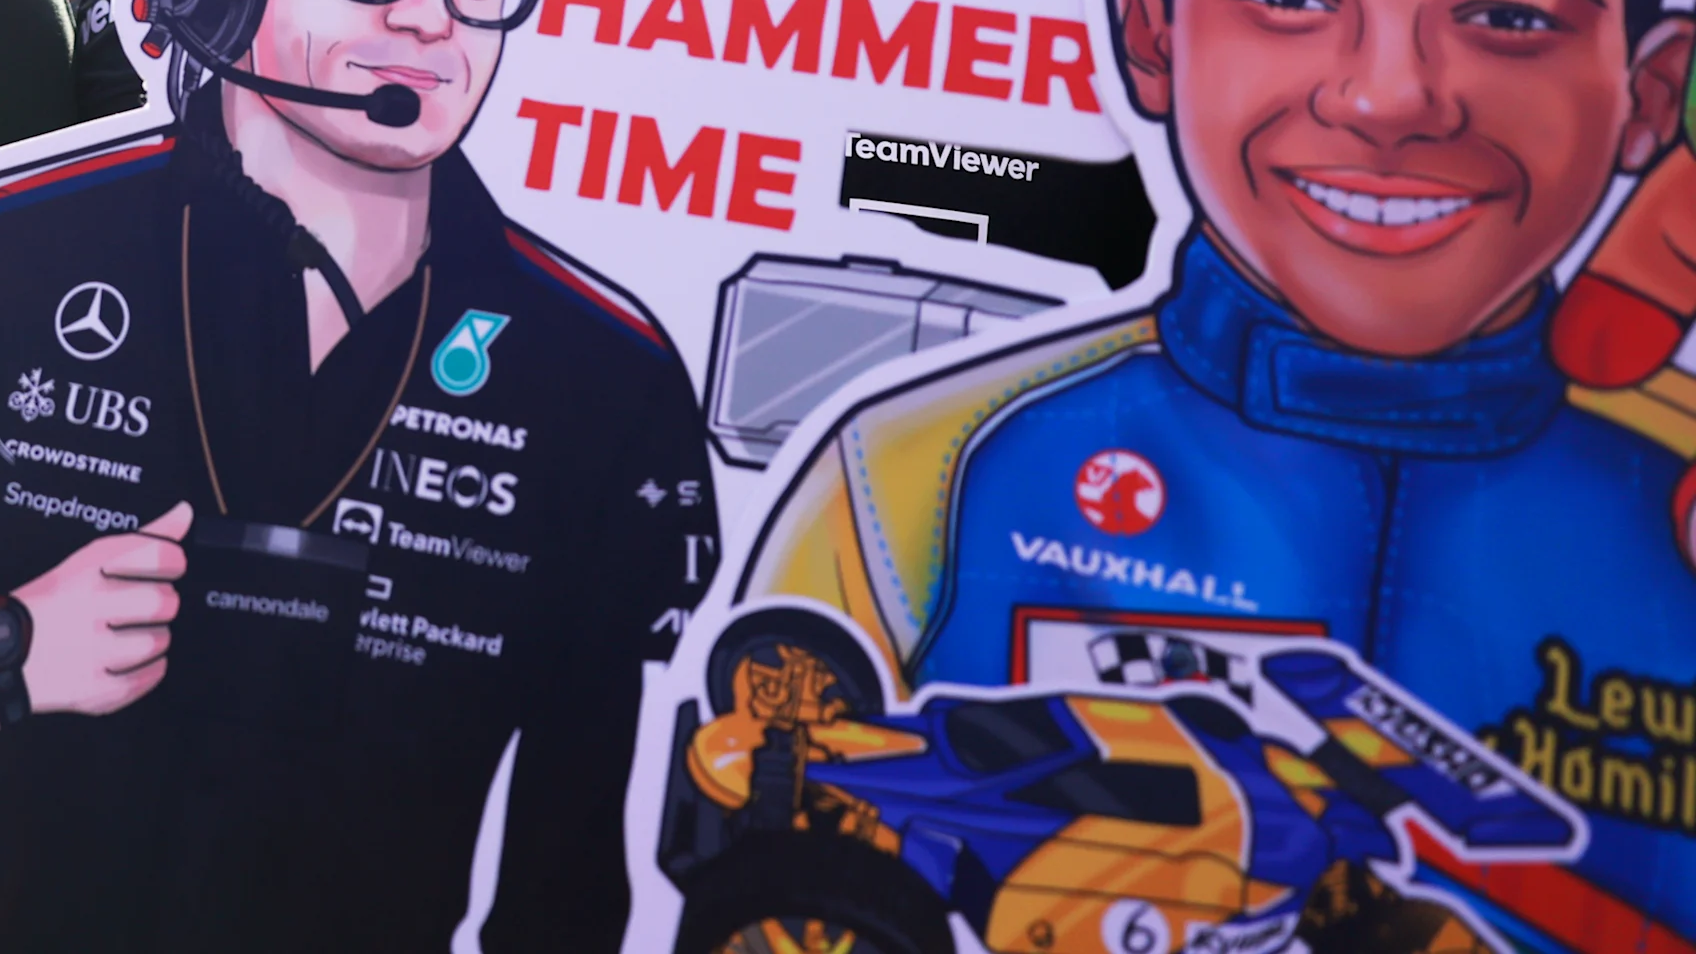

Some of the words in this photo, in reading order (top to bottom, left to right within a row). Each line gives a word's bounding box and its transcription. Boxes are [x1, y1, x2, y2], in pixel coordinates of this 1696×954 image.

[517, 97, 803, 233] TIME
[845, 133, 1040, 182] TeamViewer
[65, 382, 152, 437] UBS
[390, 404, 528, 450] PETRONAS
[4, 438, 142, 483] CROWDSTRIKE
[370, 448, 519, 515] INEOS
[4, 482, 139, 531] Snapdragon
[388, 521, 531, 573] TeamViewer
[1011, 531, 1259, 613] VAUXHALL
[206, 590, 329, 623] cannondale
[411, 615, 504, 656] Packard
[1546, 646, 1696, 744] Lew
[1509, 716, 1696, 828] Hamil
[1122, 903, 1157, 954] 6
